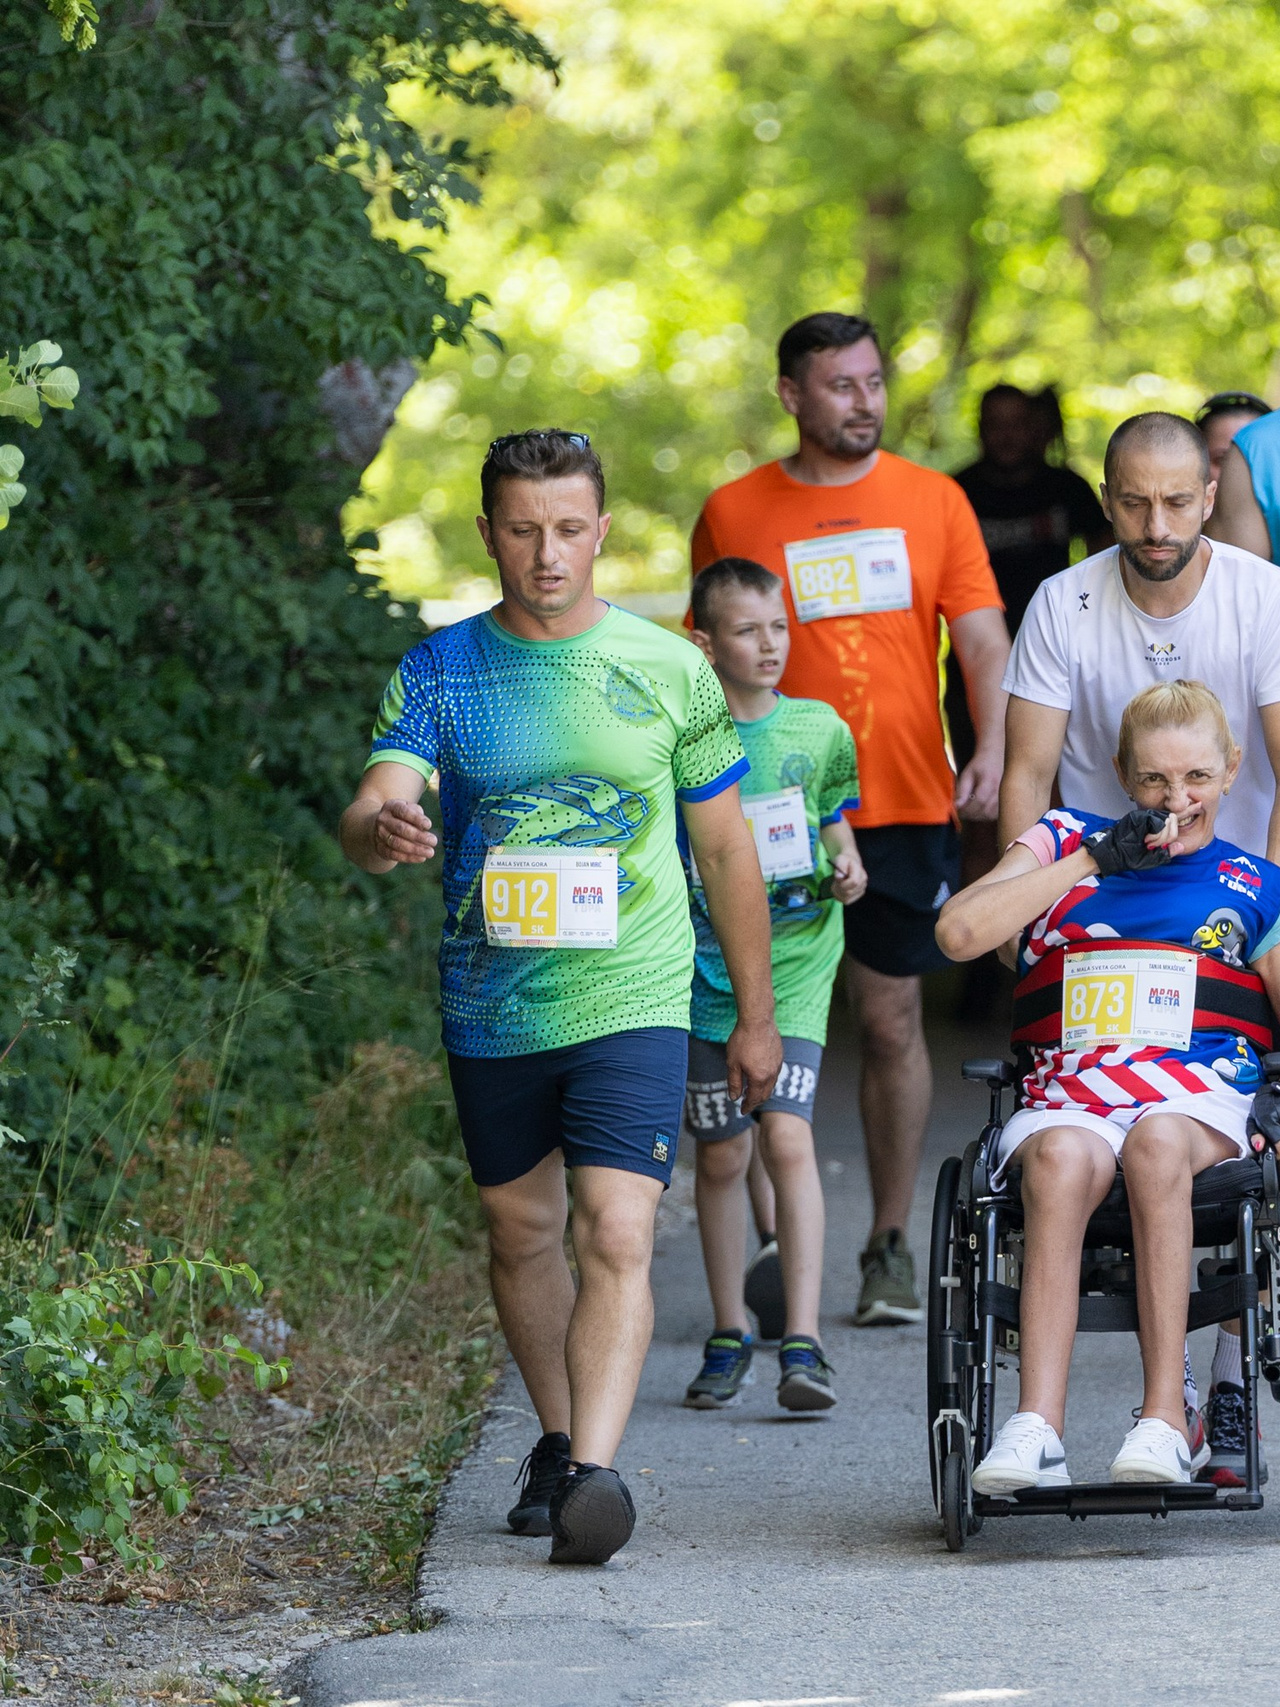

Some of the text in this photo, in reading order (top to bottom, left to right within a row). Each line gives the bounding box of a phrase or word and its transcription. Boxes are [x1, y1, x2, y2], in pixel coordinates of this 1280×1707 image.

[798, 560, 853, 597] 882
[492, 879, 549, 918] 912
[531, 925, 544, 934] 5K
[1071, 981, 1125, 1021] 873
[1106, 1024, 1119, 1033] 5K
